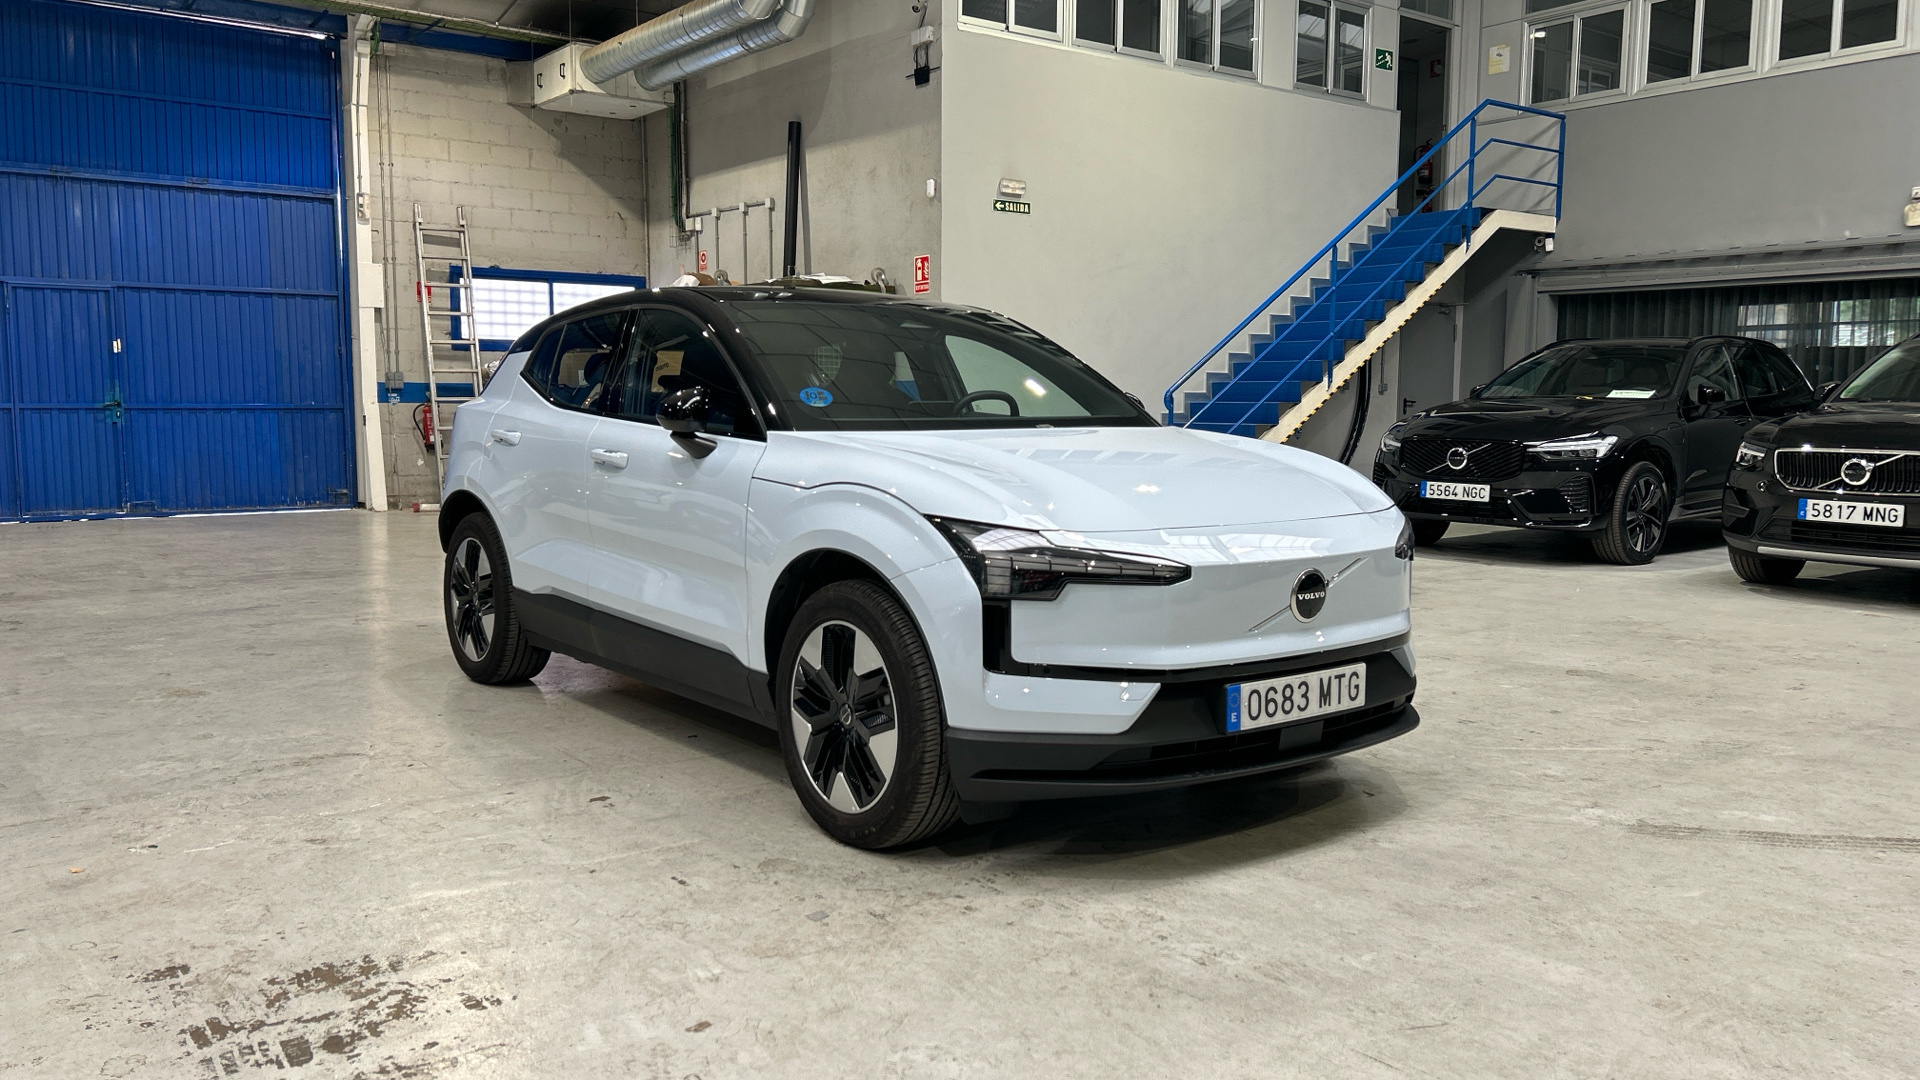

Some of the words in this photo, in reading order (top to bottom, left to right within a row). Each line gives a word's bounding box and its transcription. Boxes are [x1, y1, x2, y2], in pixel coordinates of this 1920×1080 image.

[1005, 202, 1029, 213] SALIDA
[1428, 484, 1458, 498] 5564
[1462, 486, 1486, 499] NGC
[1811, 503, 1857, 520] 5817
[1862, 506, 1899, 523] MNG
[1297, 591, 1325, 600] VOLVO
[1231, 712, 1238, 723] E
[1247, 681, 1310, 721] 0683
[1318, 671, 1360, 709] MTG
